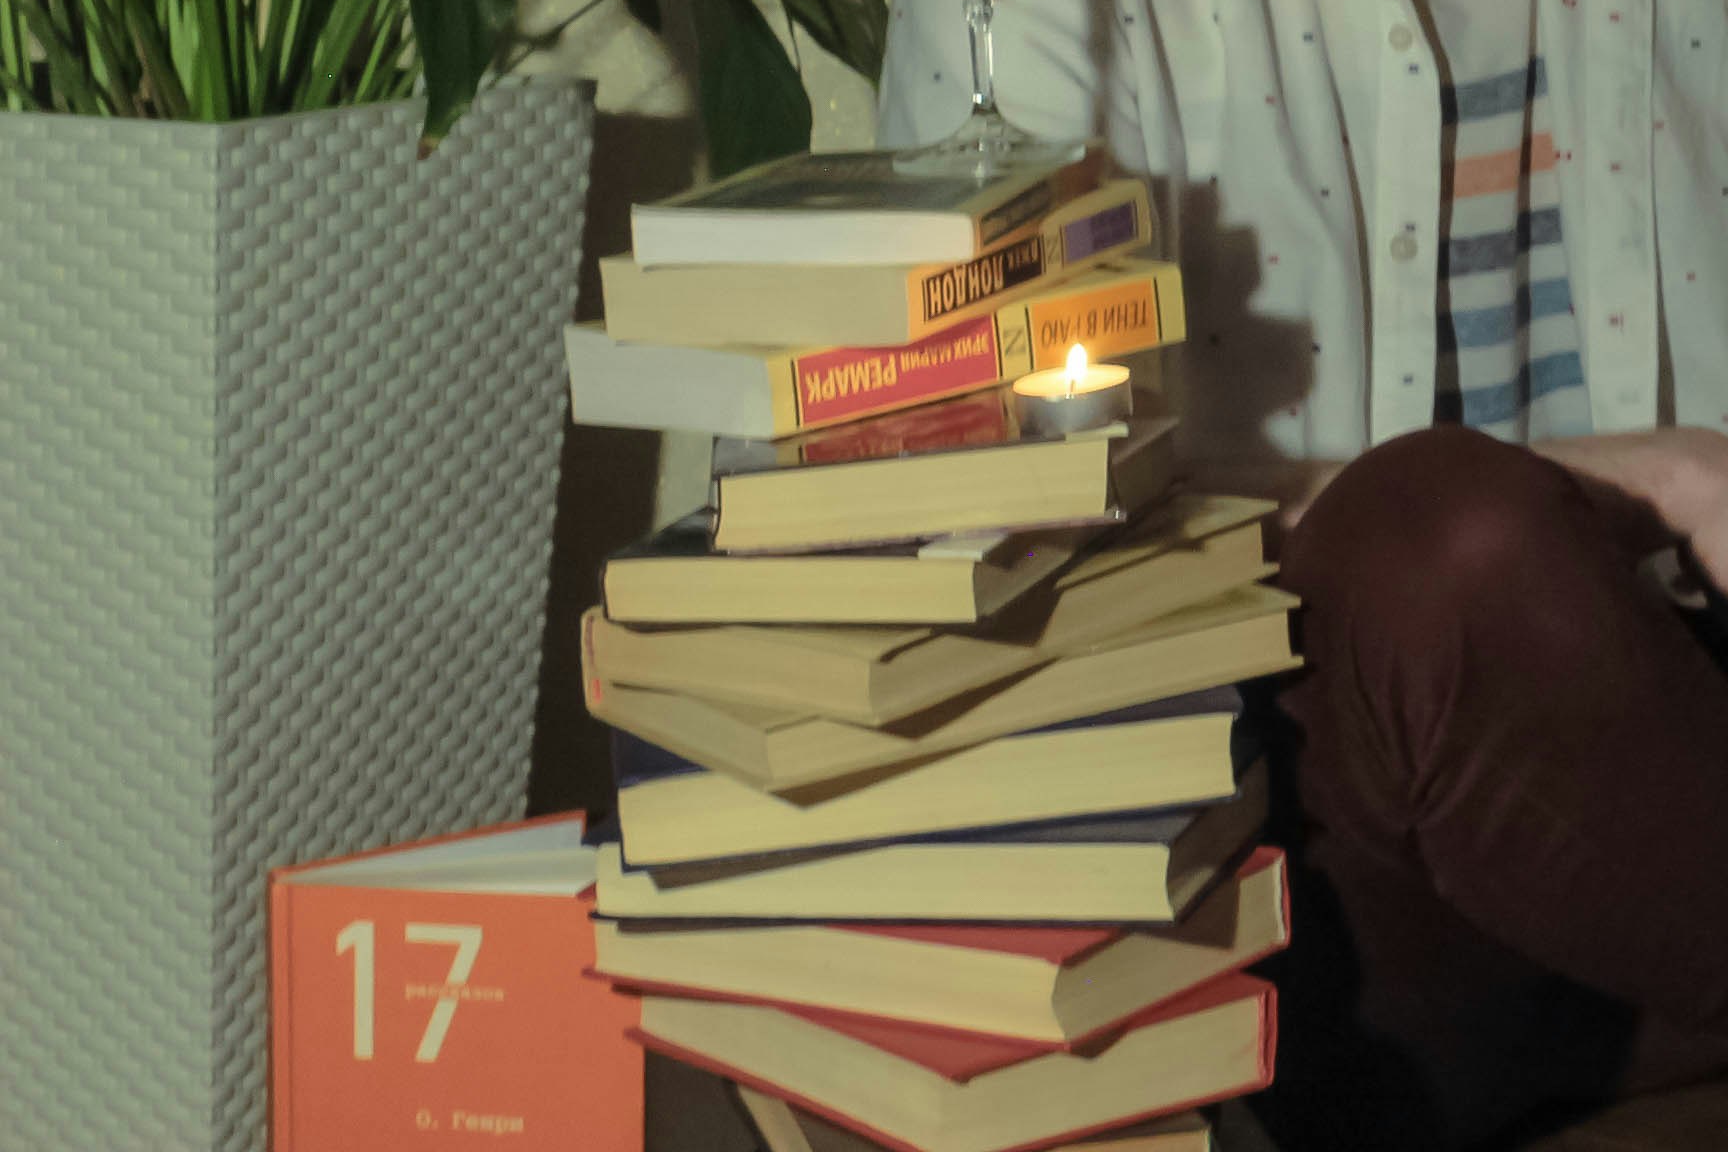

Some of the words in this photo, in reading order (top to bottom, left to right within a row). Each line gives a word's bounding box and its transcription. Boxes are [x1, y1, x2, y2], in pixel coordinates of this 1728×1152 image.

[928, 254, 1005, 317] ЛОНДОН
[1086, 310, 1099, 341] В
[1101, 297, 1148, 339] ТЕНИ
[951, 332, 991, 359] ЭРИХ
[806, 354, 897, 403] РЕМАРК
[335, 919, 483, 1063] 17
